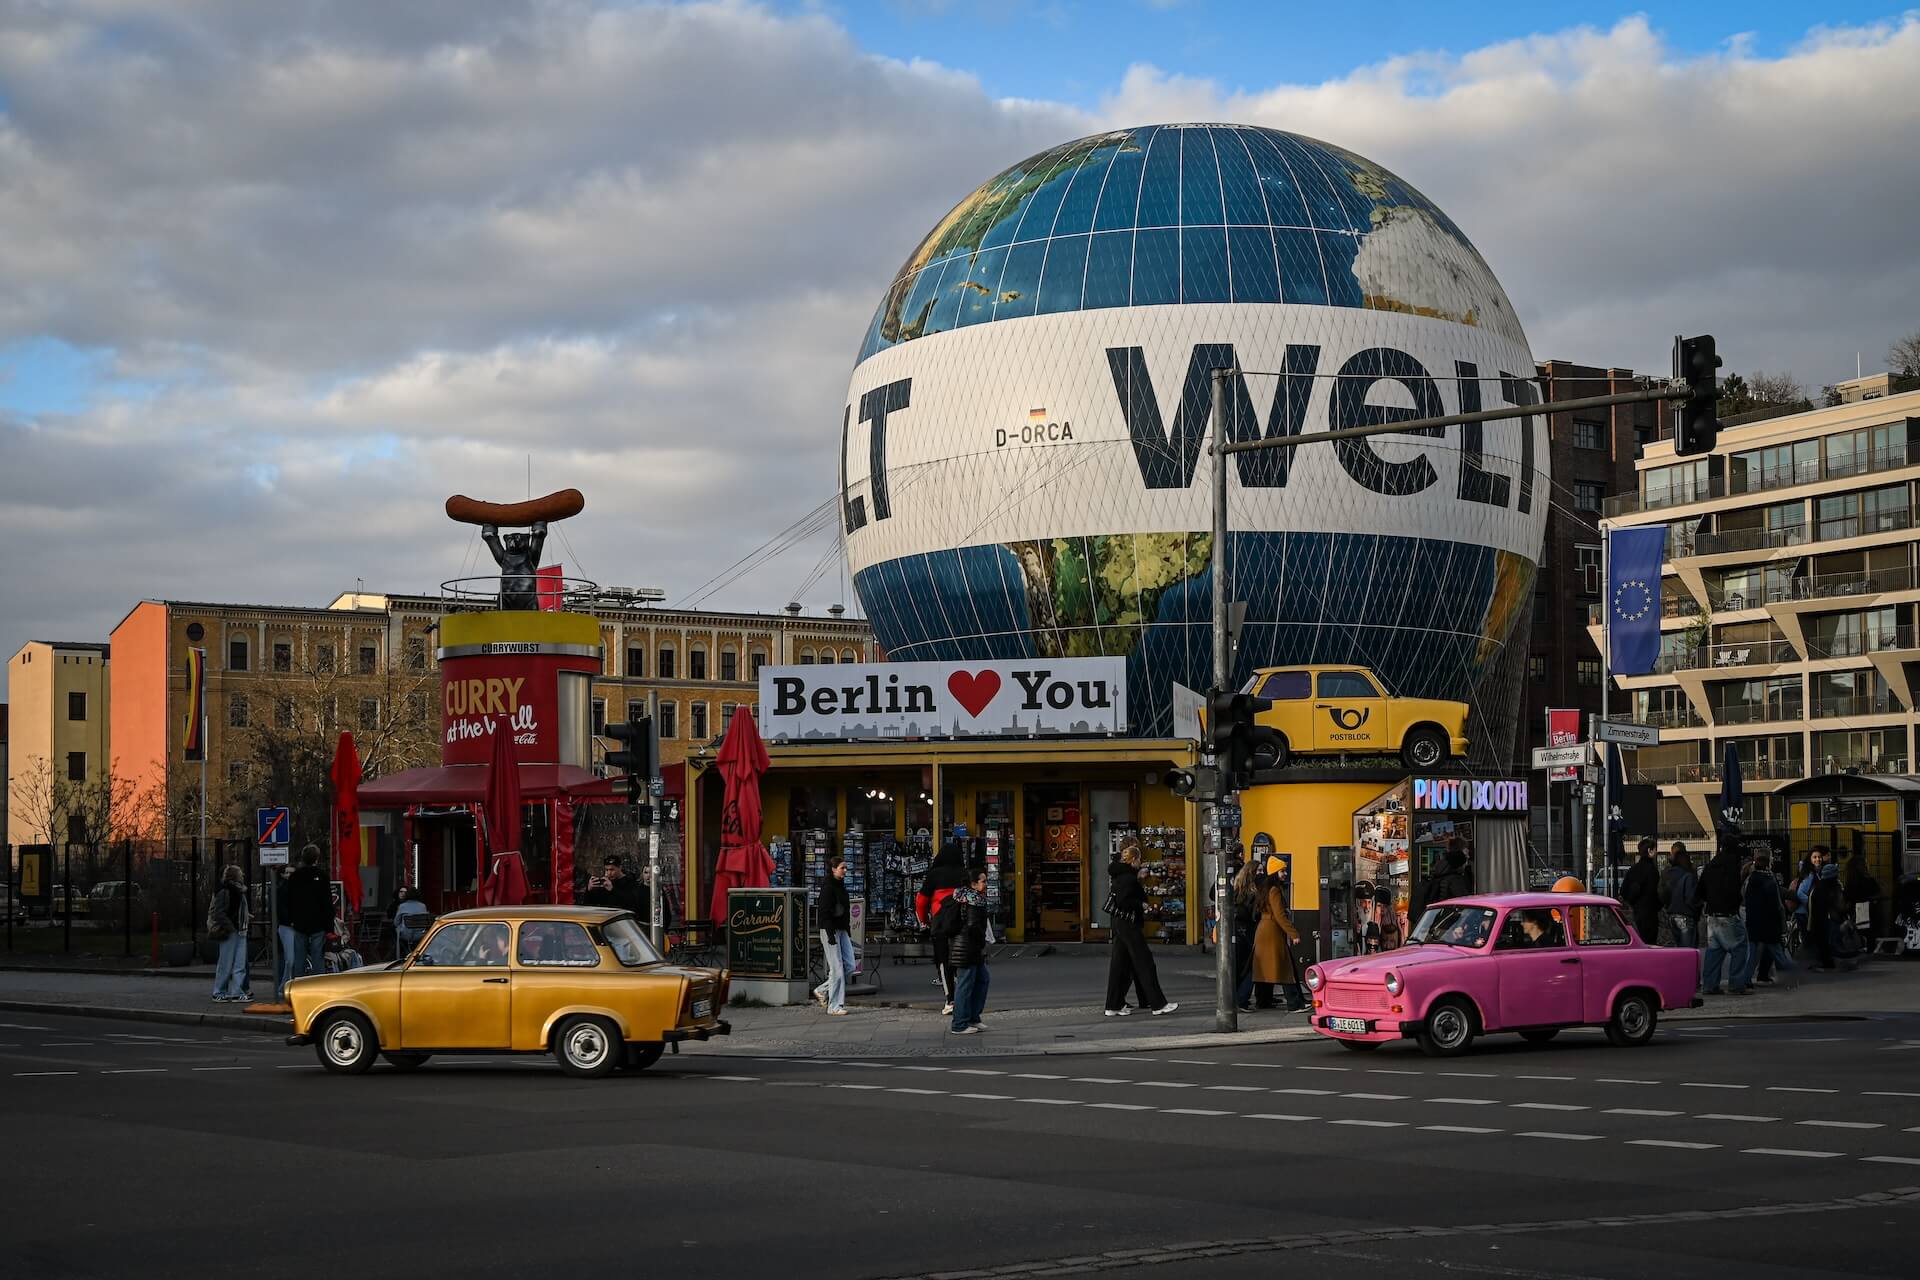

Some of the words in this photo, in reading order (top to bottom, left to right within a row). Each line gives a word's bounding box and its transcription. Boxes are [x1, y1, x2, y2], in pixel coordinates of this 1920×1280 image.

[996, 421, 1074, 447] D-ORCA
[481, 643, 540, 654] CURRYWURST
[446, 677, 526, 716] CURRY
[772, 674, 937, 717] Berlin
[1011, 670, 1111, 710] You
[446, 721, 458, 744] at
[458, 718, 484, 740] the
[1329, 733, 1372, 741] POSTBLOCK
[1552, 732, 1577, 746] Berlin
[1607, 725, 1651, 742] Zimmerstraße
[1540, 749, 1580, 763] Wilhelmstraße
[1414, 778, 1529, 811] PHOTOBOOTH
[730, 904, 784, 929] Caramel
[793, 897, 806, 953] Caramel
